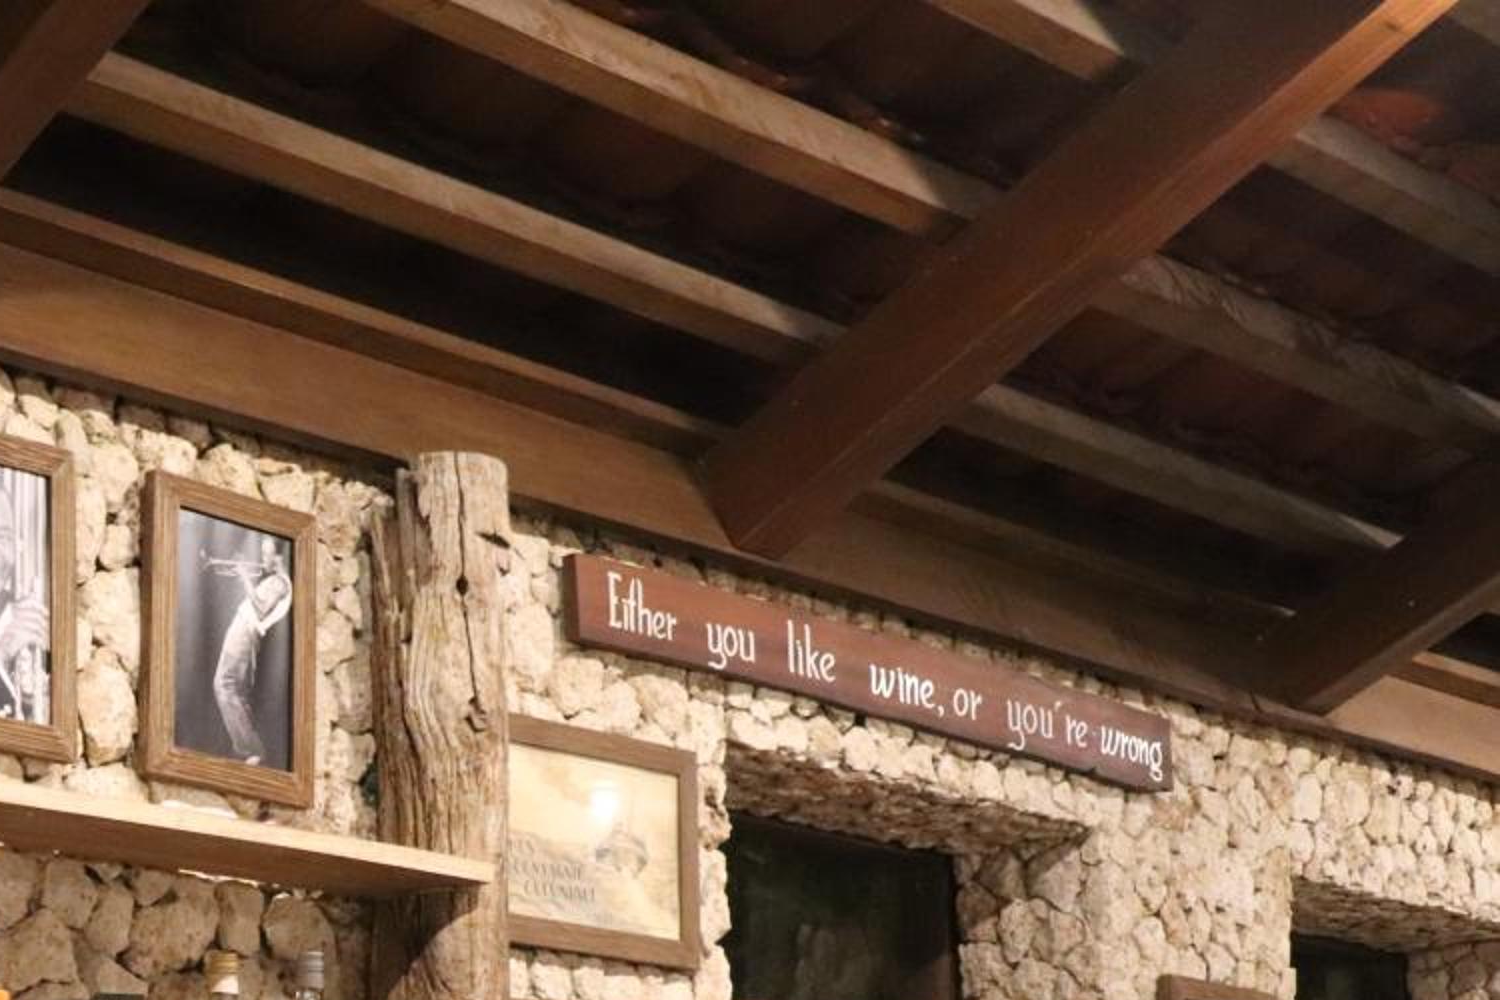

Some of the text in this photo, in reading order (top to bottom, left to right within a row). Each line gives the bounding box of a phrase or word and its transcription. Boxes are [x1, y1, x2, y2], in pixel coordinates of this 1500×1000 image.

[606, 570, 677, 642] Either
[706, 621, 755, 672] you
[787, 619, 836, 683] like
[869, 664, 945, 717] wine,
[953, 684, 983, 721] or
[1101, 723, 1164, 781] wrong
